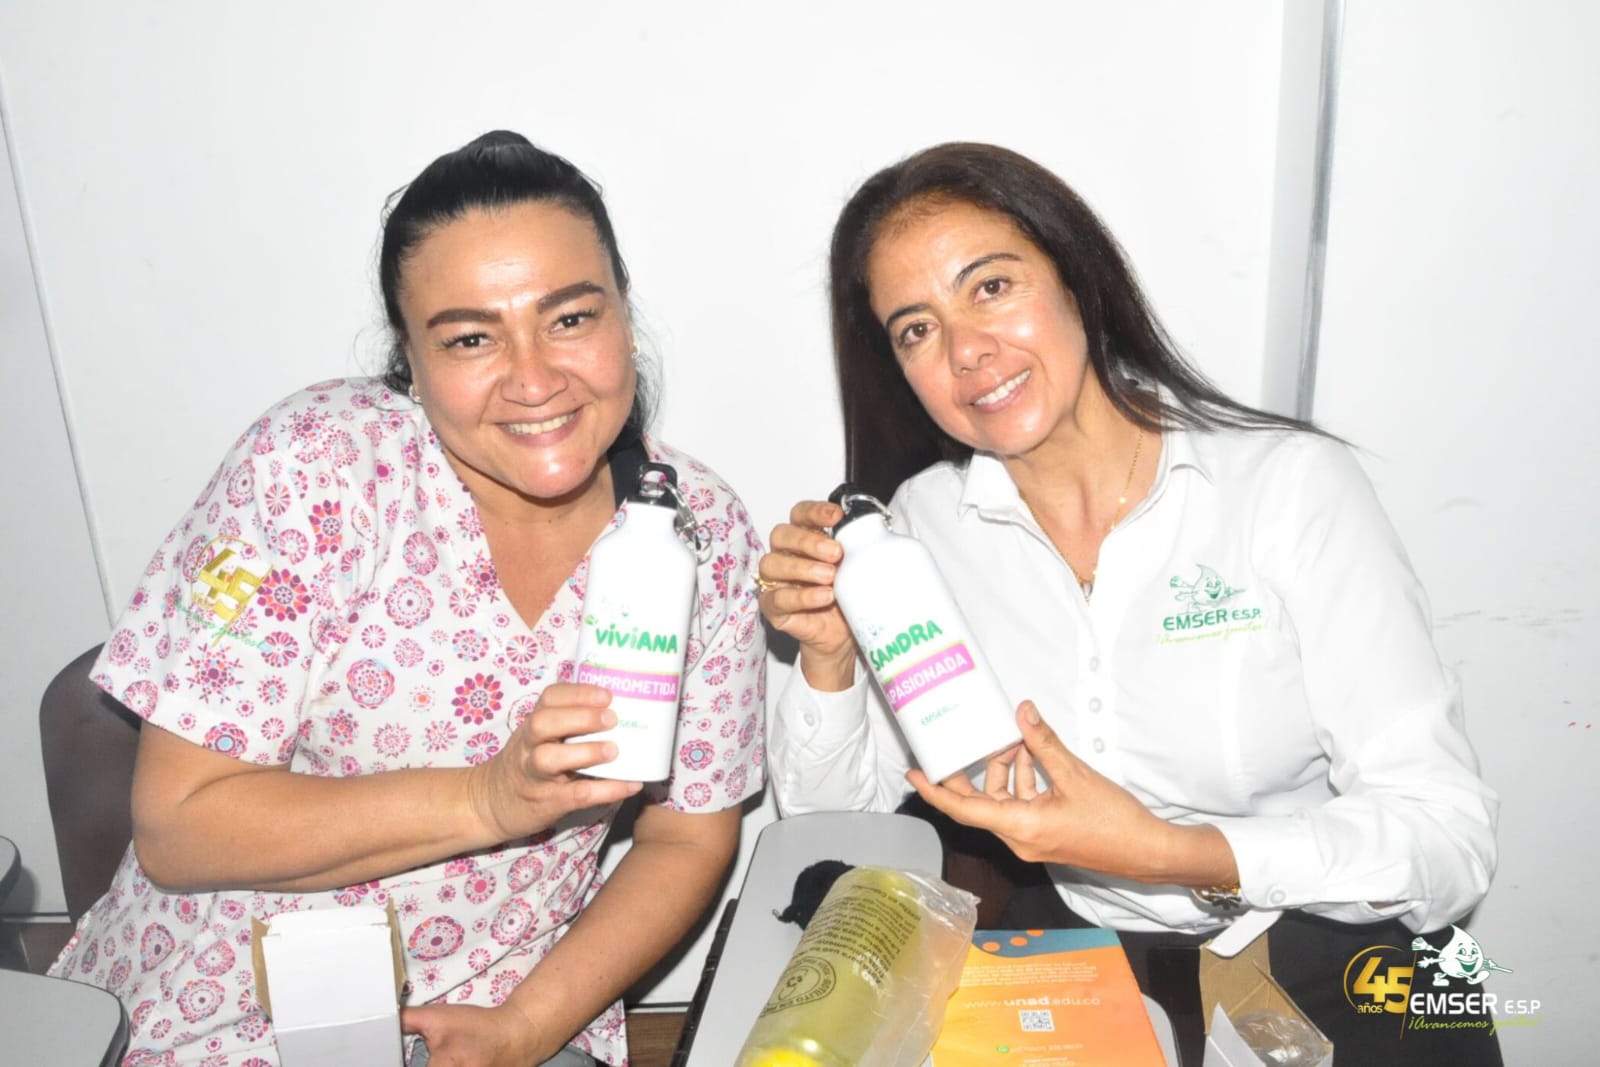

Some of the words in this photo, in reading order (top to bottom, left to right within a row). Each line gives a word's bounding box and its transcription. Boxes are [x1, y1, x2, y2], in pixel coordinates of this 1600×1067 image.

[1163, 609, 1229, 631] EMSER
[869, 619, 943, 671] SANDRA
[579, 671, 676, 696] COMPROMETIDA
